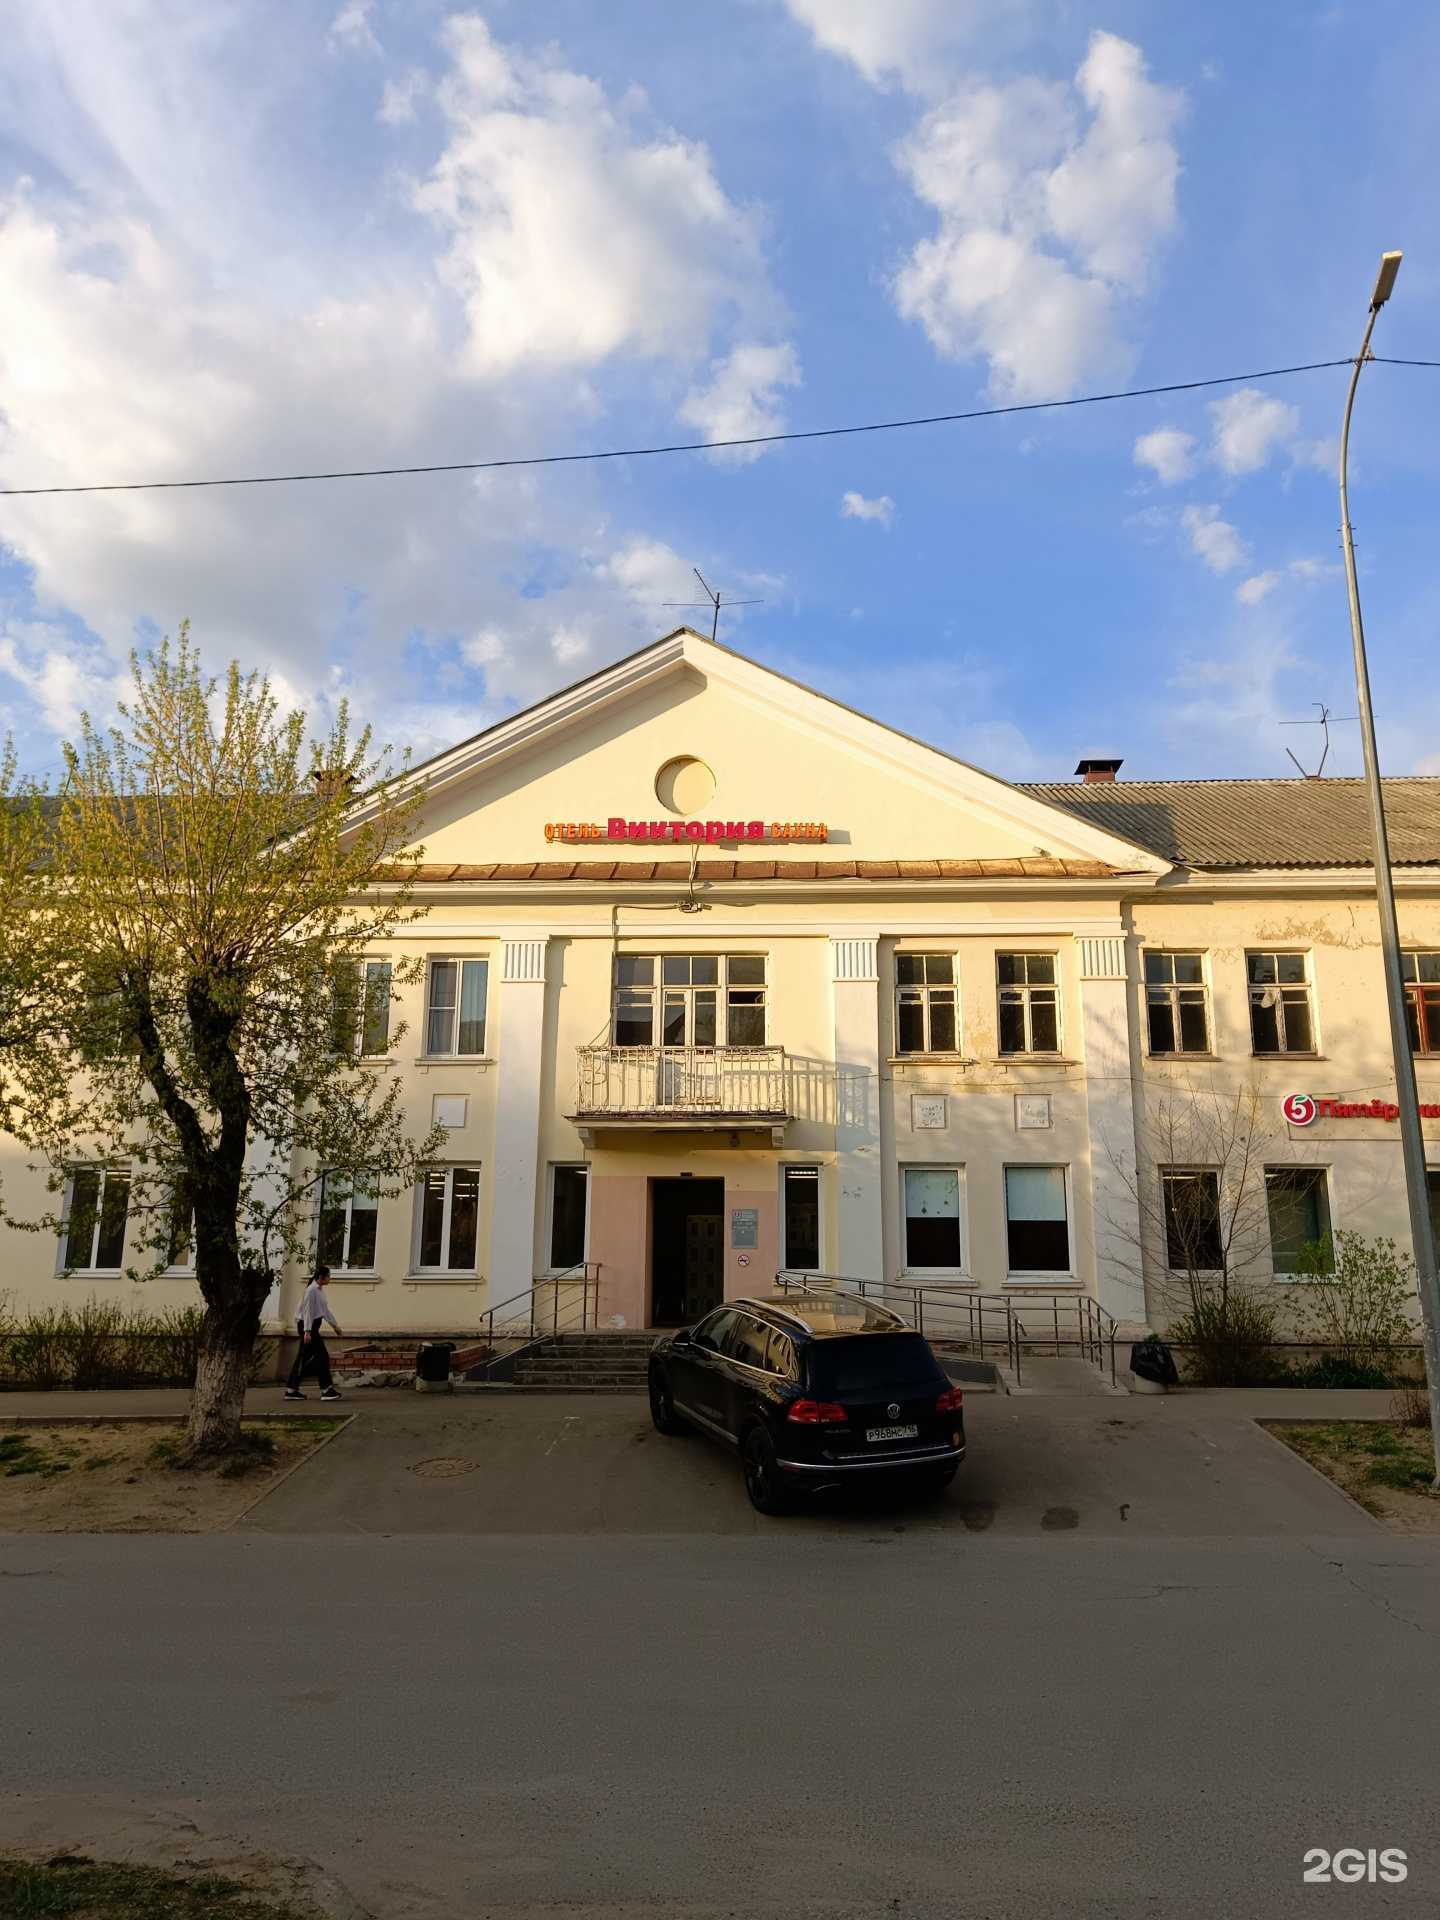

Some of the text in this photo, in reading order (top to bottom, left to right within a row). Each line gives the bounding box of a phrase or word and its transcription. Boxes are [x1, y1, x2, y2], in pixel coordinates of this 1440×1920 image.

[544, 817, 828, 843] ОТЕЛЬ Виктория САУНА
